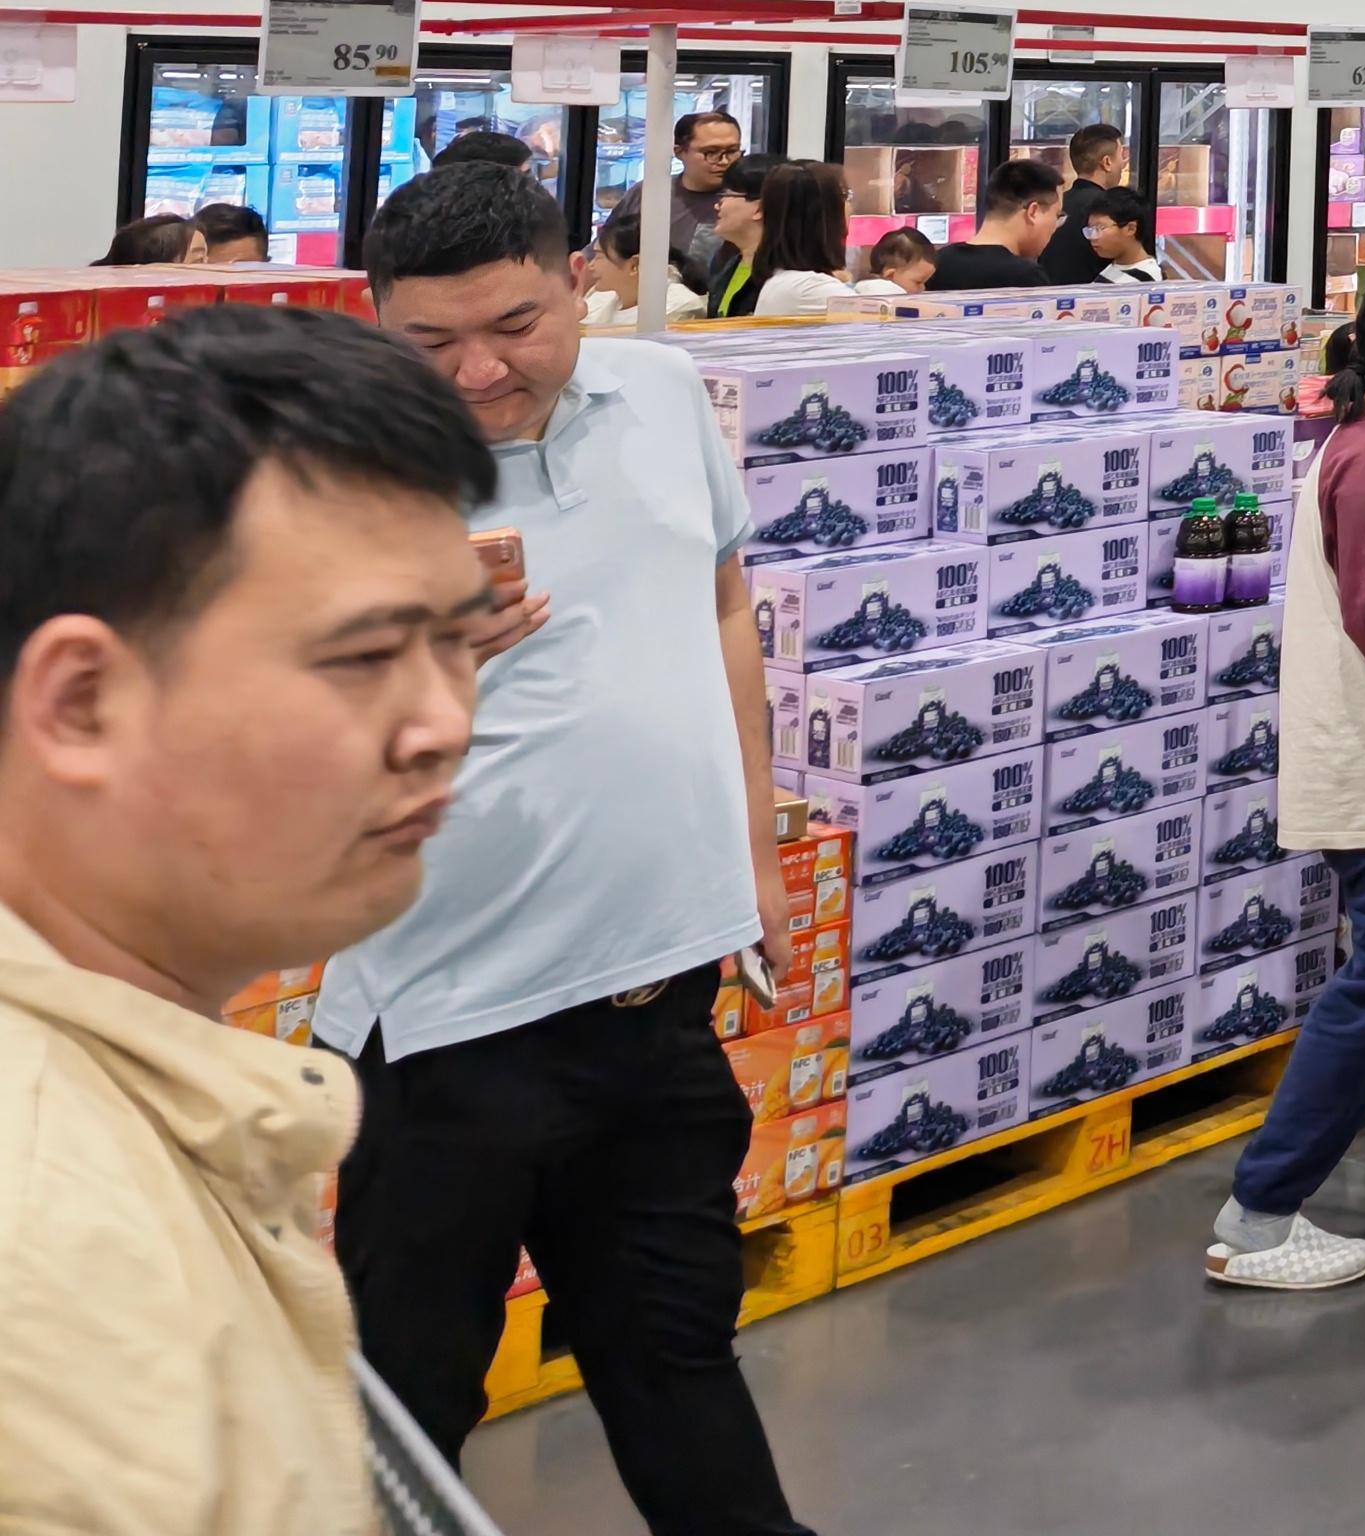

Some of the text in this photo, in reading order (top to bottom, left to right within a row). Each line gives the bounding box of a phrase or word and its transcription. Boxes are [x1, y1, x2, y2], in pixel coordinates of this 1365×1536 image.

[987, 352, 1024, 375] 100%
[1137, 341, 1172, 363] 100%
[876, 369, 918, 396] 100%
[1252, 430, 1285, 453] 100%
[876, 461, 918, 488] 100%
[1103, 447, 1140, 472] 100%
[1102, 536, 1139, 562] 100%
[936, 561, 979, 591] 100%
[1160, 633, 1198, 662] 100%
[993, 665, 1034, 696] 100%
[1163, 722, 1199, 752] 100%
[992, 760, 1034, 793] 100%
[1156, 813, 1193, 844] 100%
[985, 856, 1027, 890] 100%
[1150, 902, 1188, 935] 100%
[982, 951, 1024, 985] 100%
[1148, 991, 1185, 1025] 100%
[977, 1045, 1020, 1081] 100%
